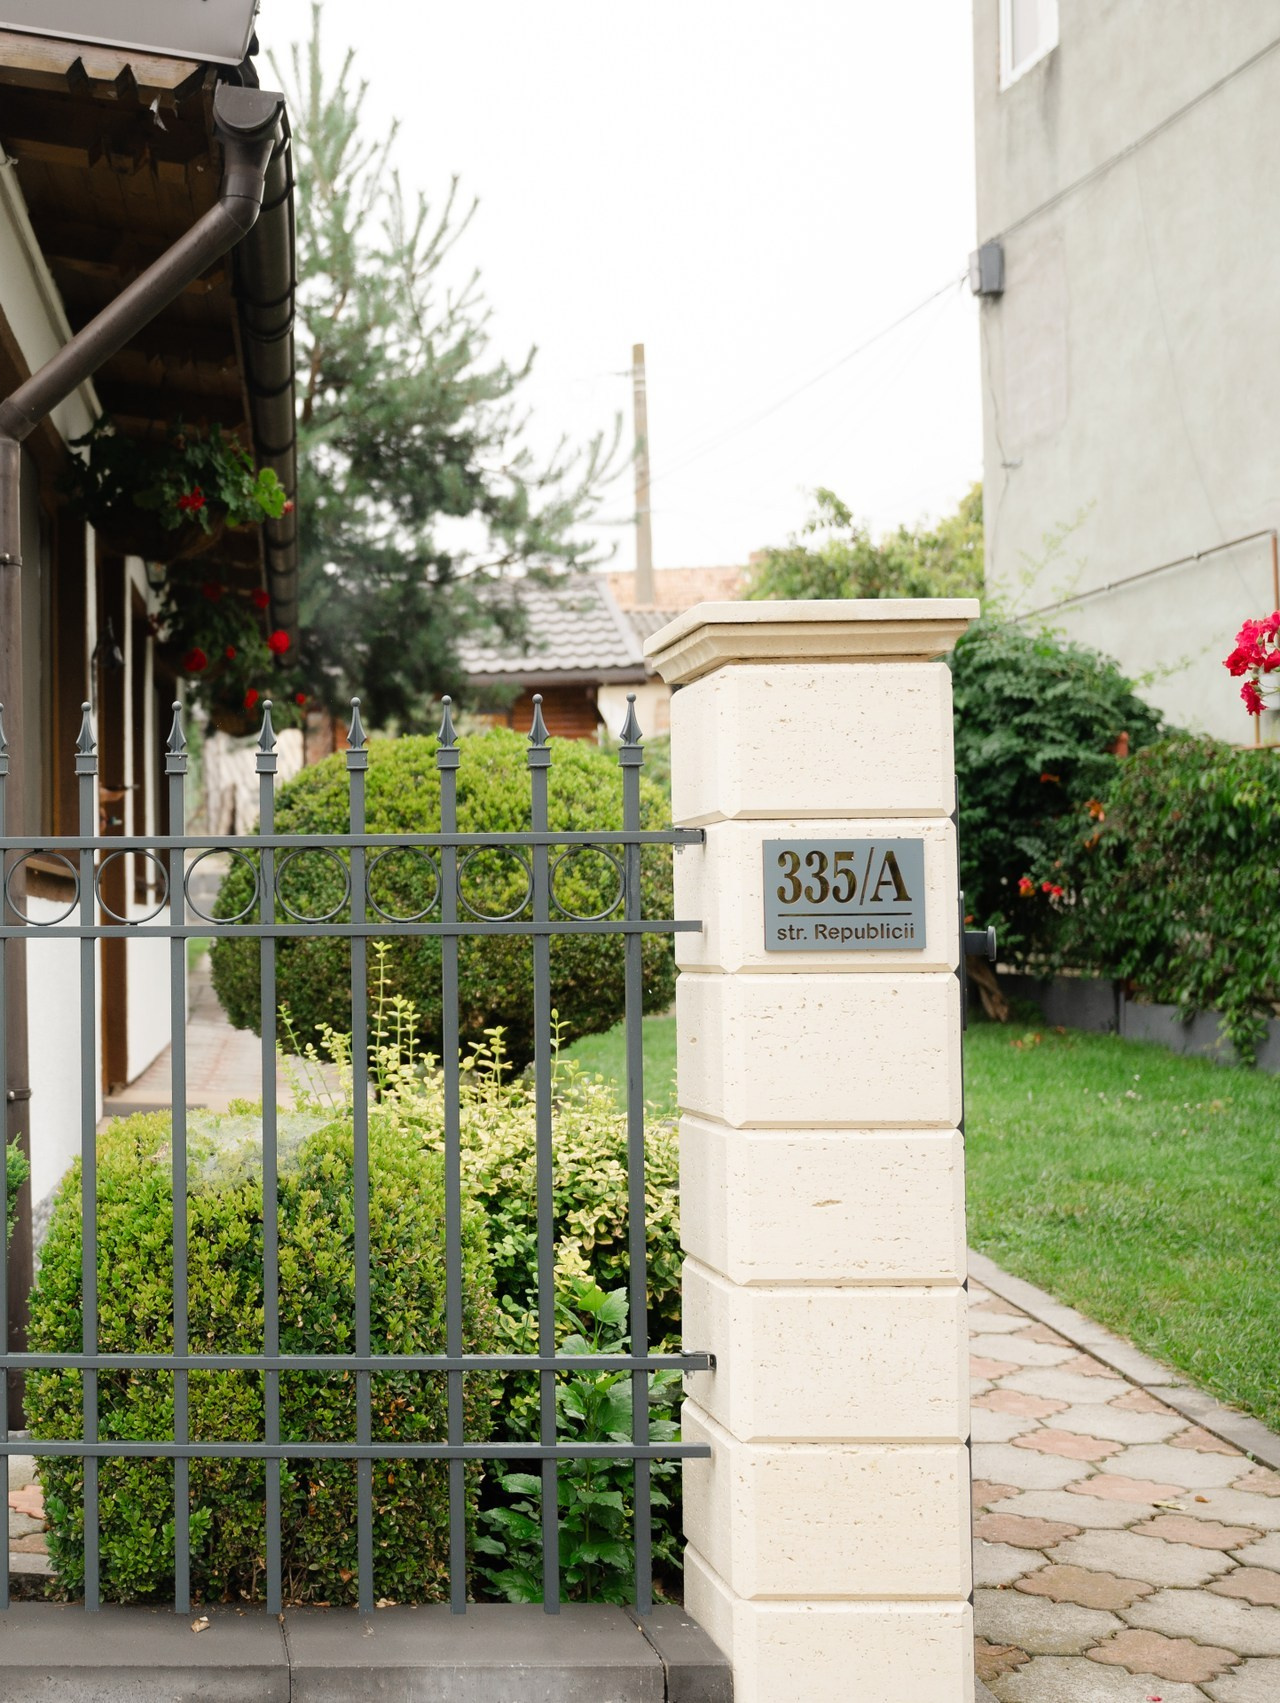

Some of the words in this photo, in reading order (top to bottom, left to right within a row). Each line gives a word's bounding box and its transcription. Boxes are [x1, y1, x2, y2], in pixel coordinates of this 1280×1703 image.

[776, 847, 913, 906] 335/A
[777, 924, 808, 941] str.
[814, 922, 915, 943] Republicii
